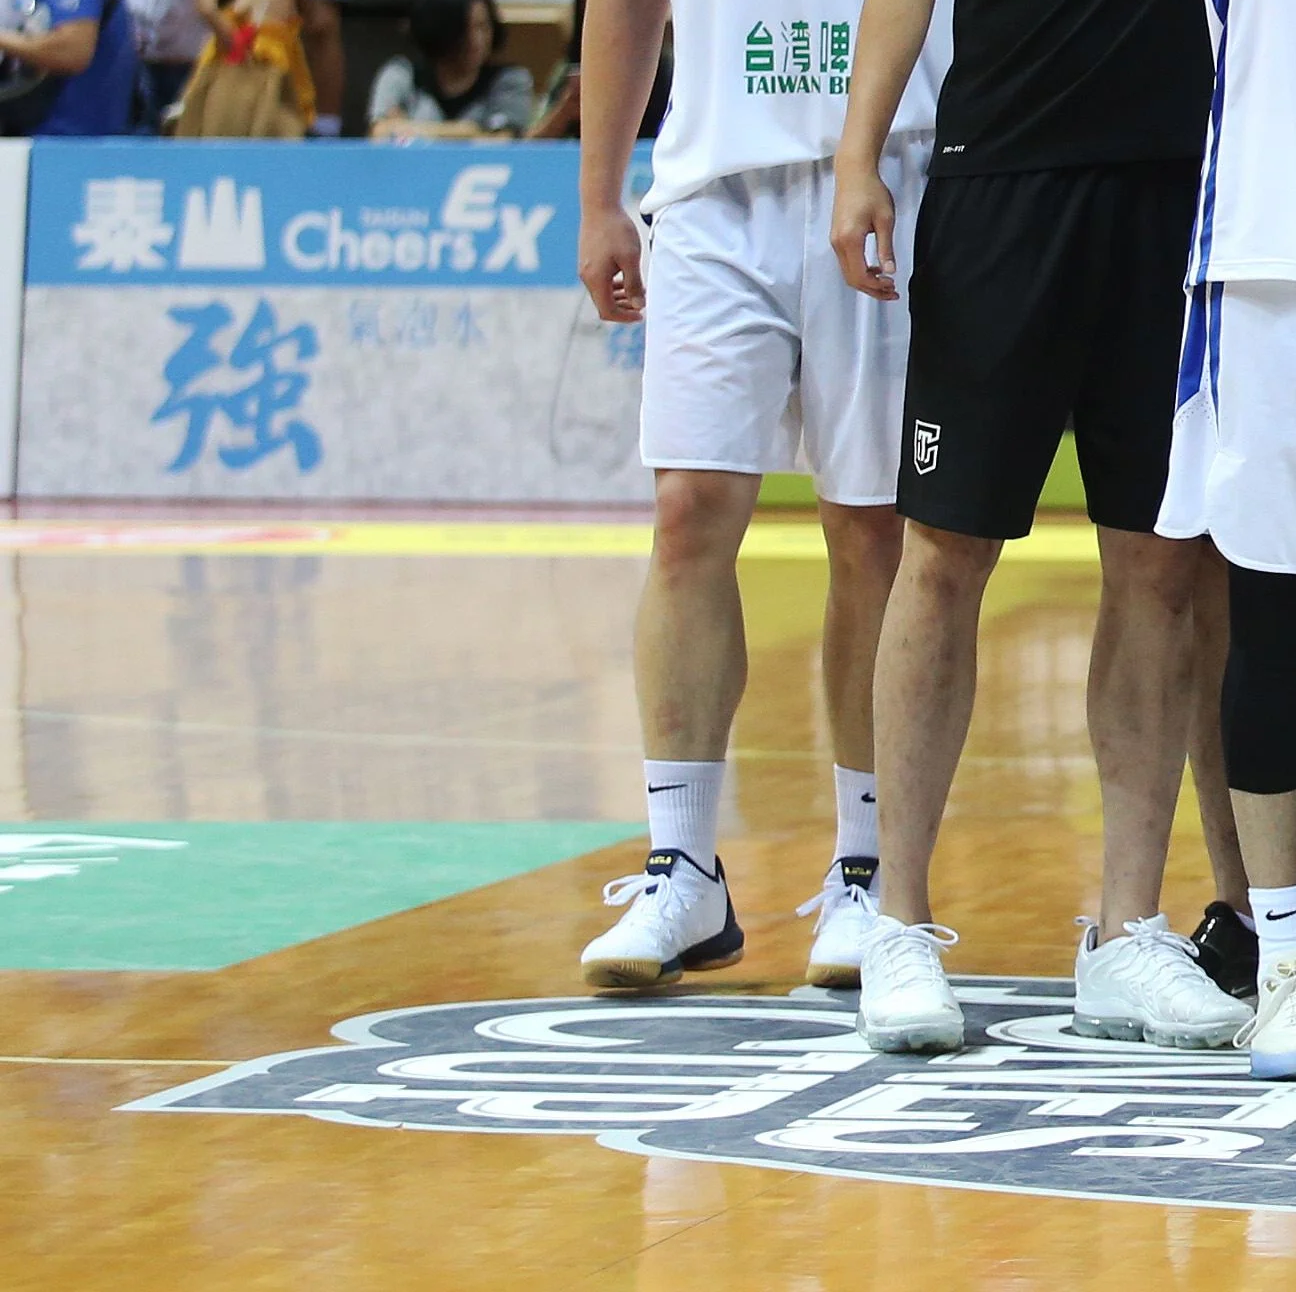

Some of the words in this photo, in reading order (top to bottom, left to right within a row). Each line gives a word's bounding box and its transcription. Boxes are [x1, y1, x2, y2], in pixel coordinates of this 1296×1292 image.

[744, 75, 821, 95] TAIWAN
[72, 175, 265, 272] 泰山
[282, 208, 477, 272] Cheers
[151, 298, 324, 475] 強
[294, 1007, 871, 1122] CUP
